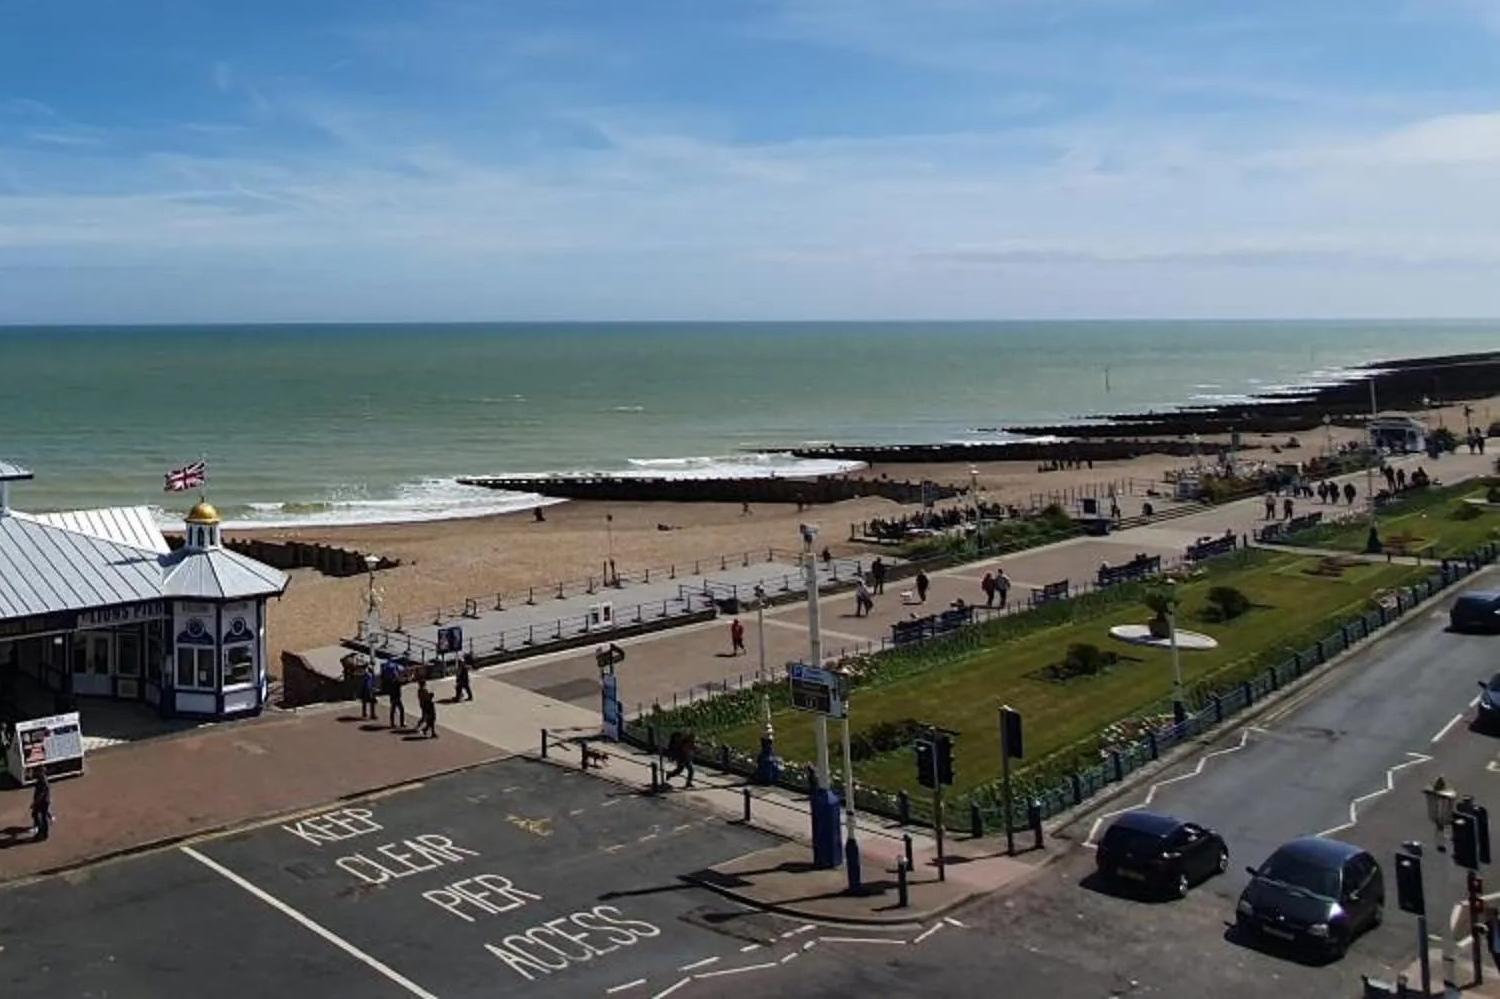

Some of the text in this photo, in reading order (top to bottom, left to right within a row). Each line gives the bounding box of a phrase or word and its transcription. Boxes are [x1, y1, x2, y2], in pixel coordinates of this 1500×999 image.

[281, 808, 384, 847] KEEP
[335, 834, 480, 884] CLEAR
[421, 874, 543, 922] PIER
[484, 905, 660, 981] ACCESS
